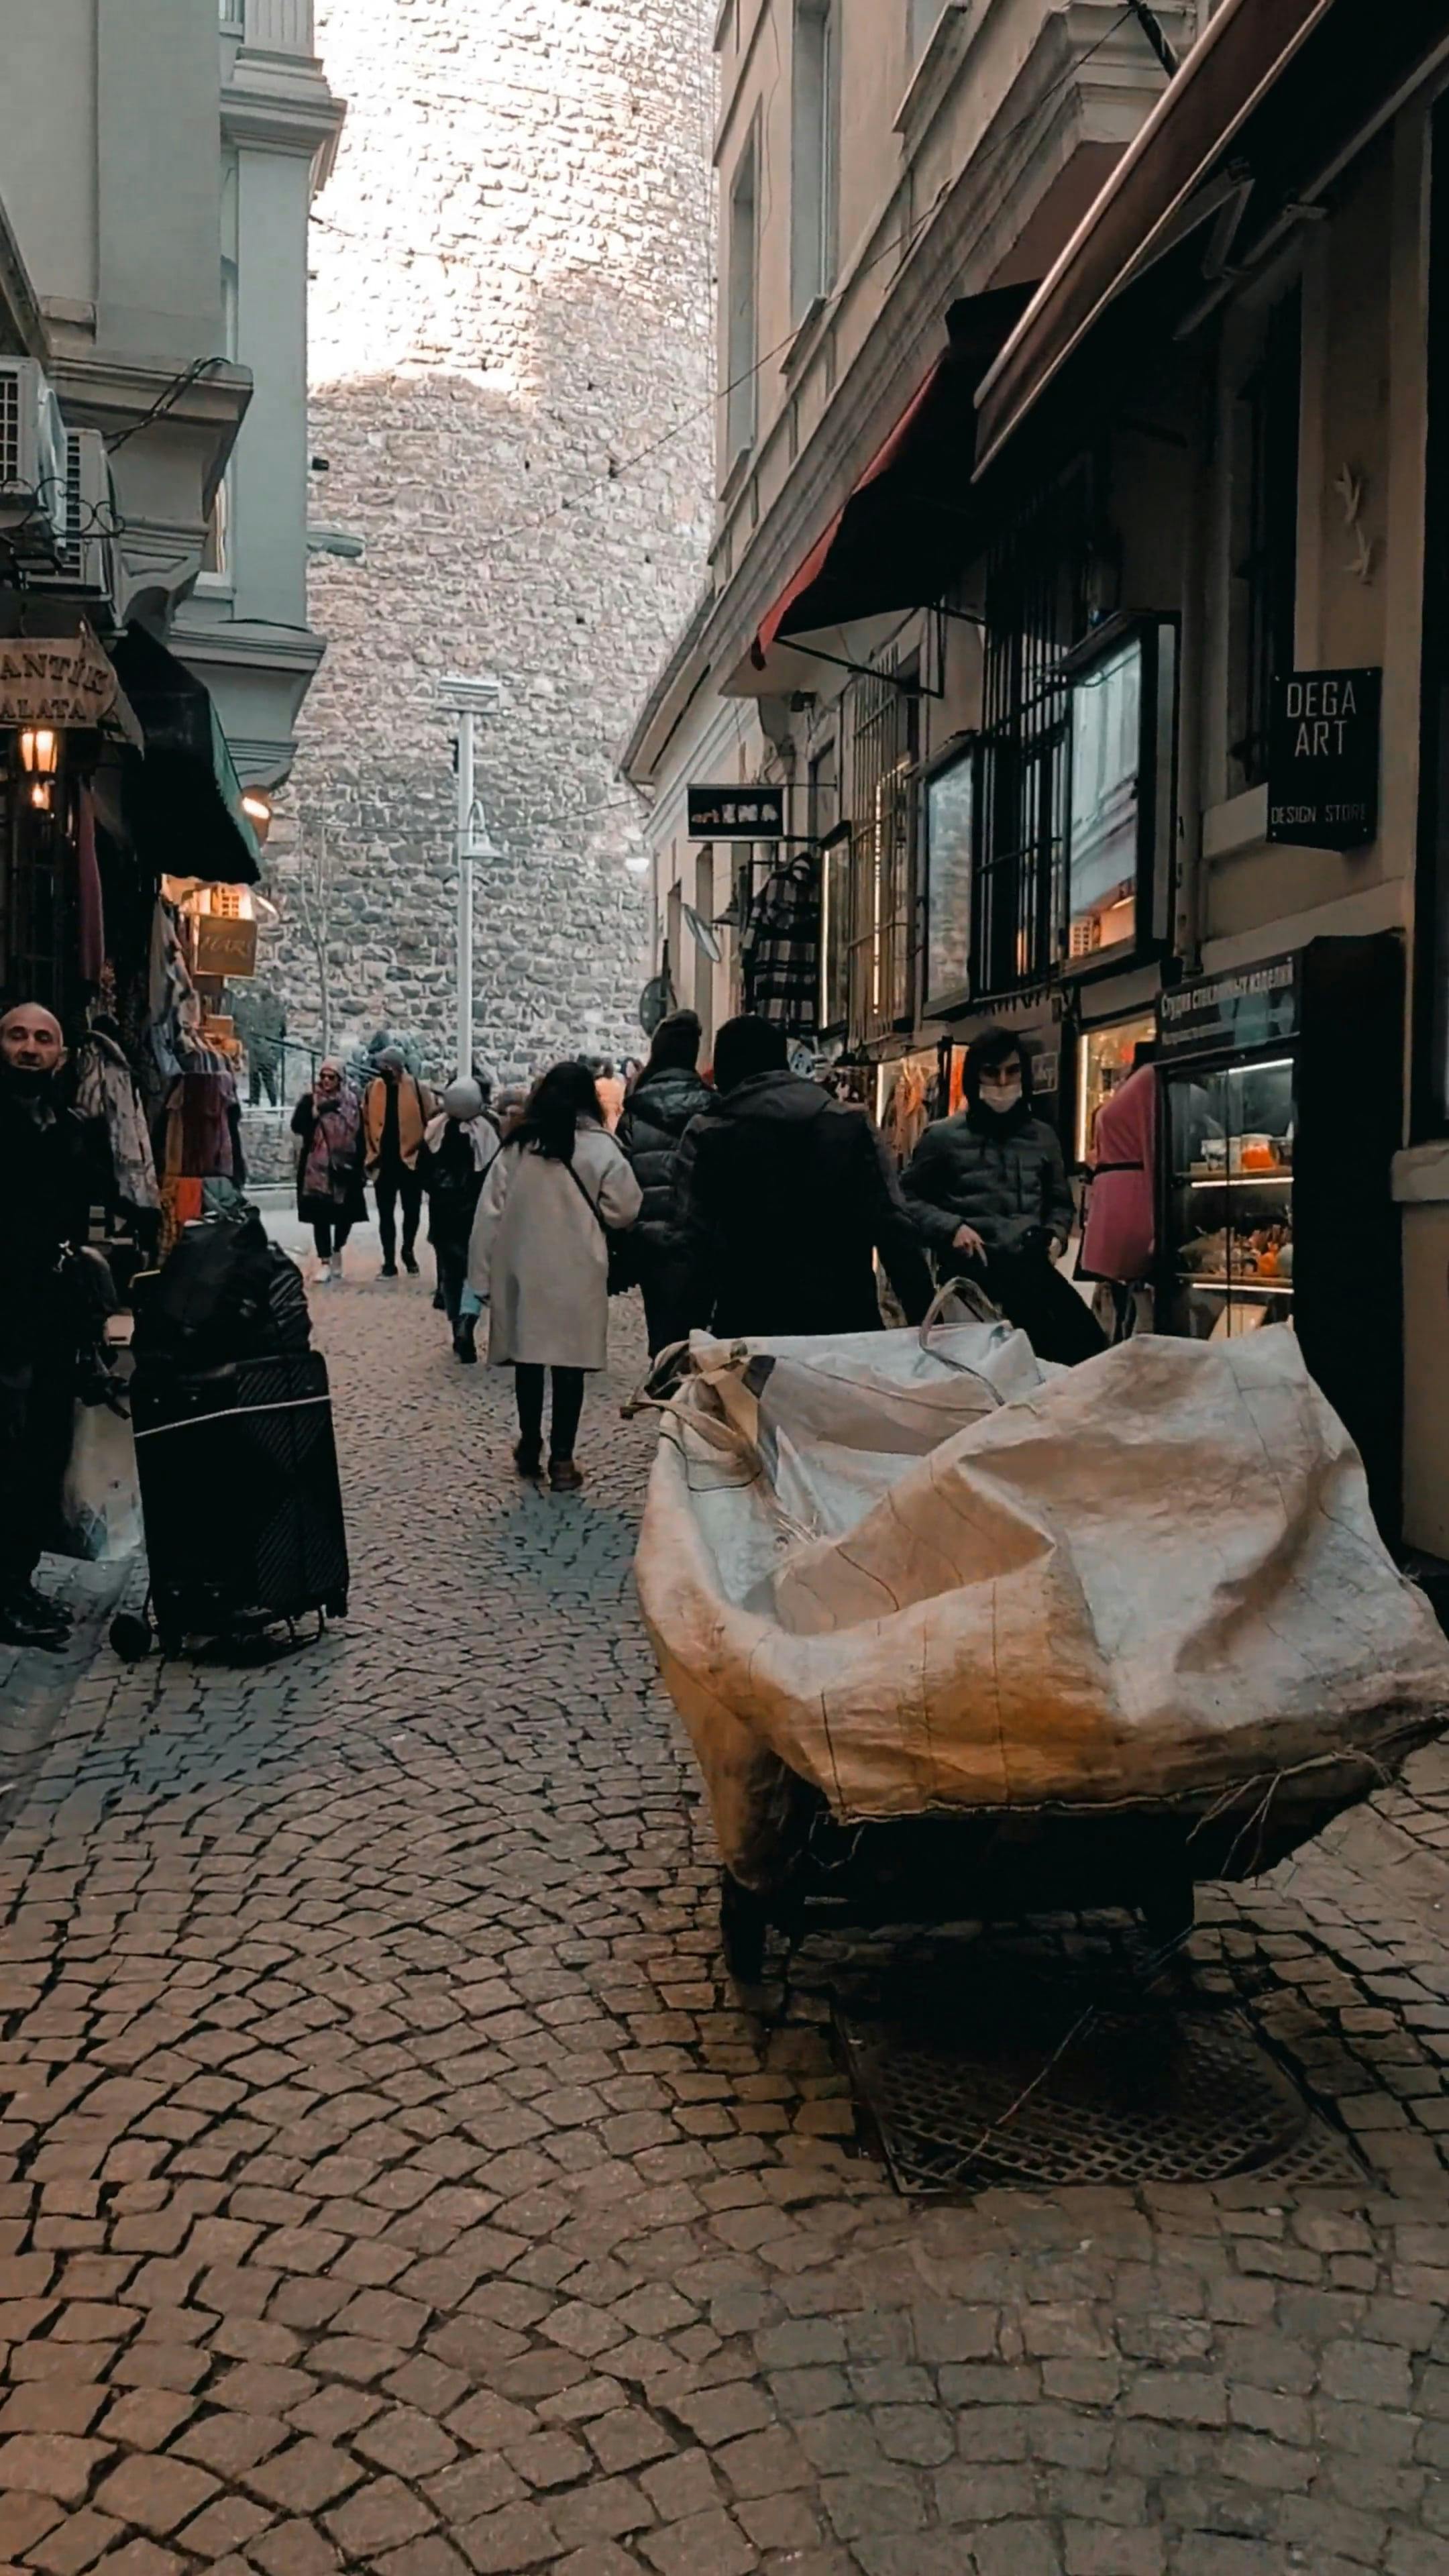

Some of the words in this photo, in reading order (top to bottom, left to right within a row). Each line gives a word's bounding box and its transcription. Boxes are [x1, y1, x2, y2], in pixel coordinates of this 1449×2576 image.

[1287, 681, 1356, 718] DEGA
[1294, 720, 1347, 757] ART
[1271, 806, 1316, 824] DESIGN
[1326, 804, 1366, 822] STORE
